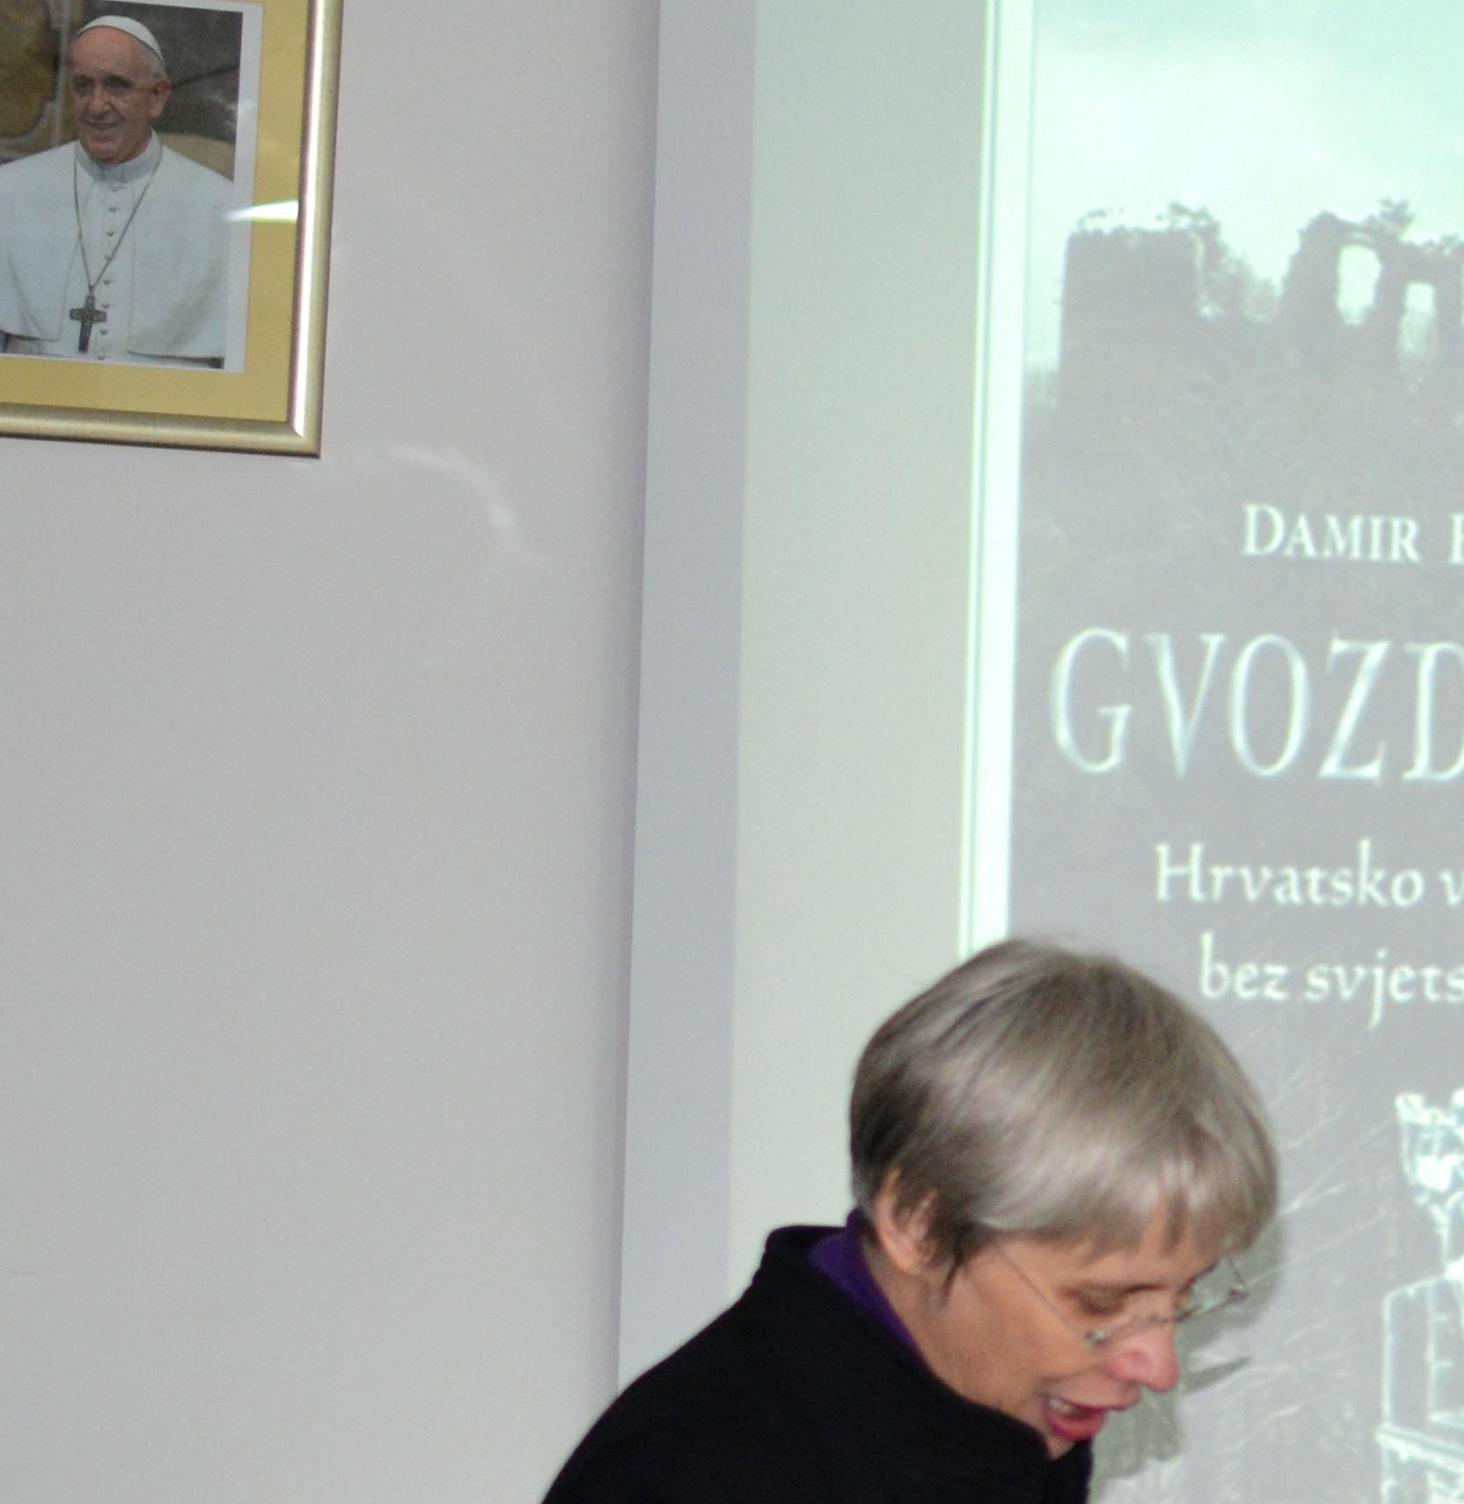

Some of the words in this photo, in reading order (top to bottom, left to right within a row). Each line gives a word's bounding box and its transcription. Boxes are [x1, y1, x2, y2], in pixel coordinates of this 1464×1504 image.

[1243, 502, 1420, 564] DAMIR
[1154, 838, 1425, 908] Hrvatsko
[1199, 931, 1288, 1002] bez
